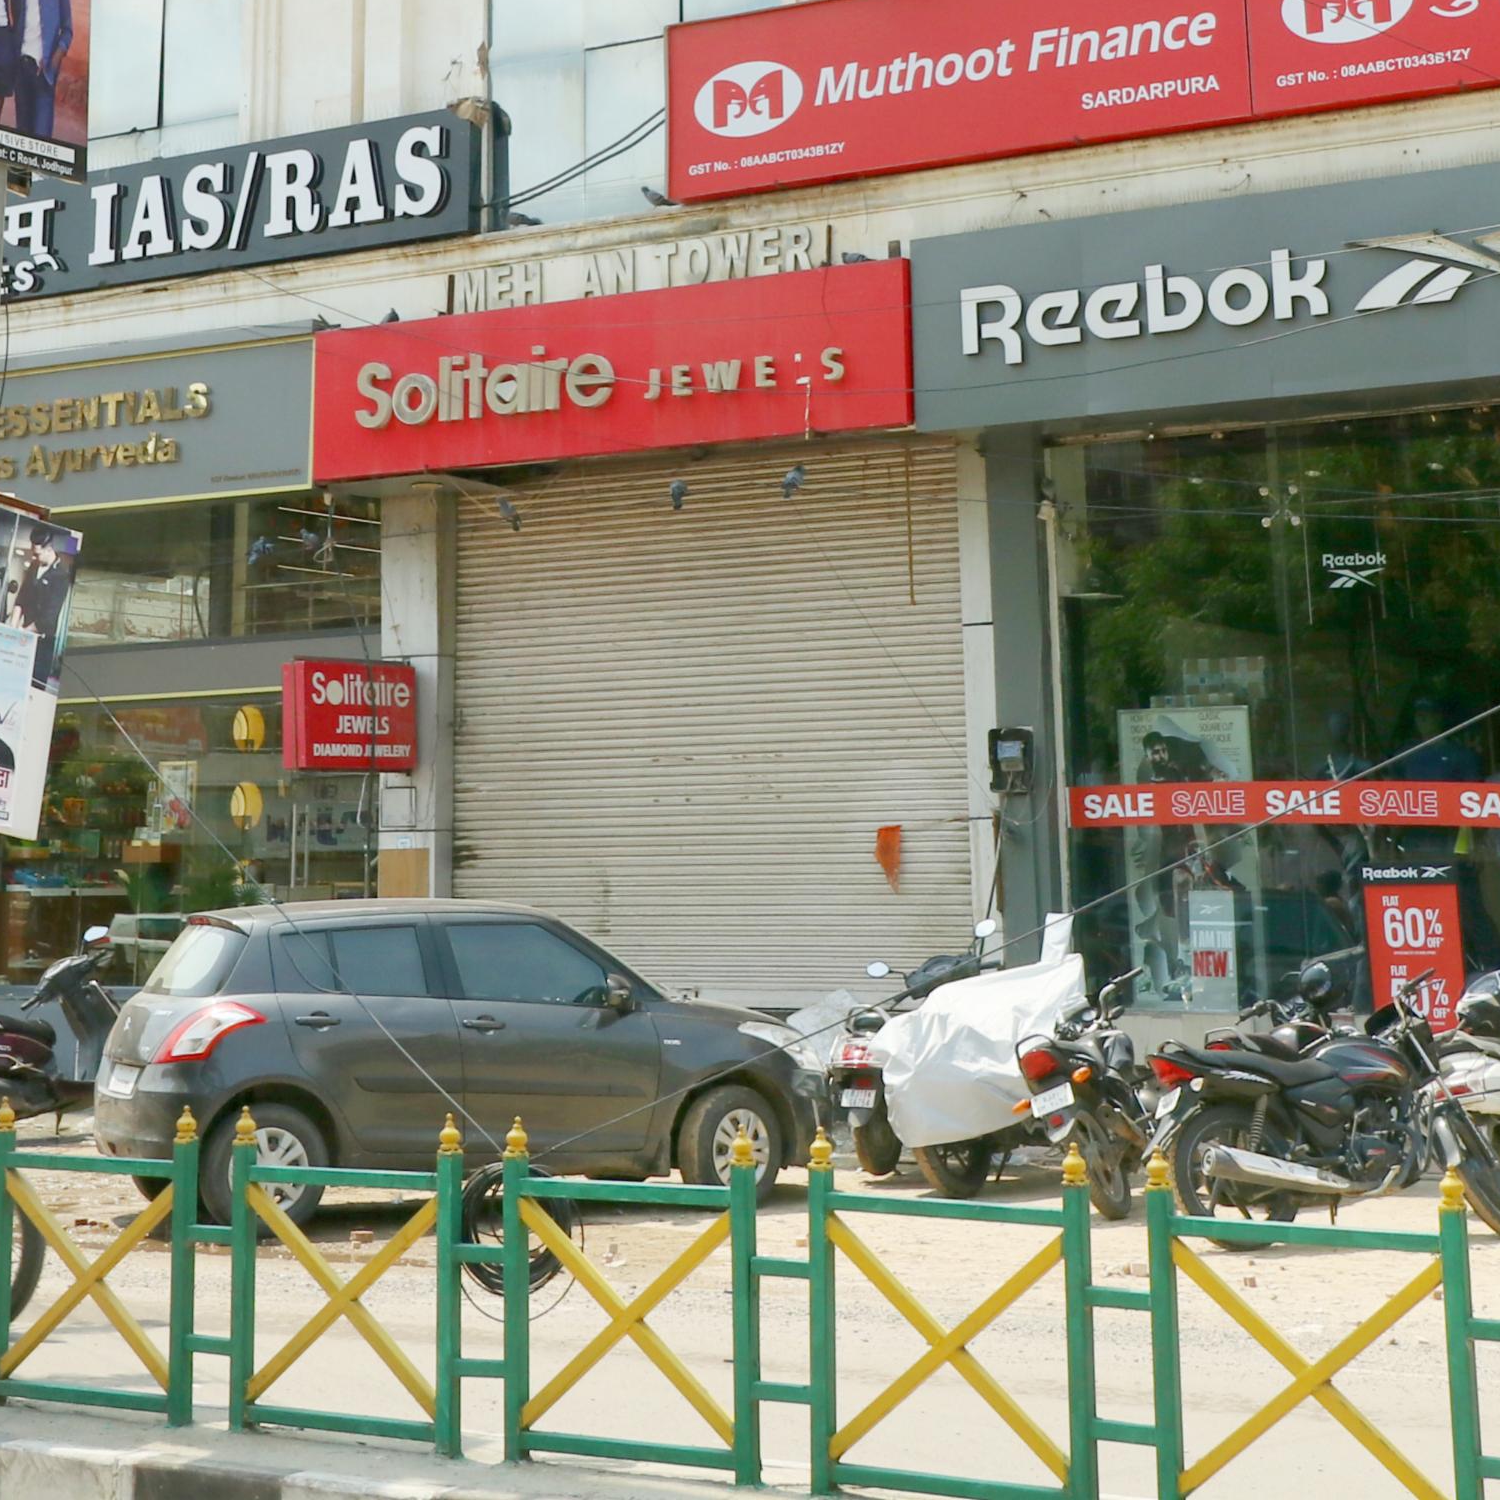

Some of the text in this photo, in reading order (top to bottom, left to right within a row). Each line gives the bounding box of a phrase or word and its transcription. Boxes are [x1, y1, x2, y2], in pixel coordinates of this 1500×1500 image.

[813, 10, 1218, 107] Muthoot Finance
[1276, 71, 1305, 88] GST
[1307, 69, 1330, 82] No.
[1080, 73, 1220, 111] SARDARPURA
[28, 140, 59, 157] STORE
[41, 158, 74, 177] Jodhpur
[688, 161, 712, 176] GST
[714, 159, 732, 172] No.
[88, 123, 448, 268] IAS/RAS
[654, 225, 813, 288] TOWER
[959, 248, 1330, 365] Reebok
[355, 345, 615, 431] Solitaire
[25, 430, 179, 484] Ayurveda
[1322, 551, 1387, 569] Reebok
[311, 671, 411, 708] Solitaire
[336, 714, 390, 735] JEWELS
[313, 743, 363, 757] DIAMOND
[1083, 793, 1154, 819] SALE
[1171, 790, 1245, 817] SALE
[1265, 790, 1341, 816] SALE
[1359, 790, 1438, 818] SALE
[1362, 866, 1419, 881] Reebok
[1382, 895, 1399, 907] FLAT
[1383, 907, 1444, 949] 60%
[1390, 965, 1408, 977] FLAT
